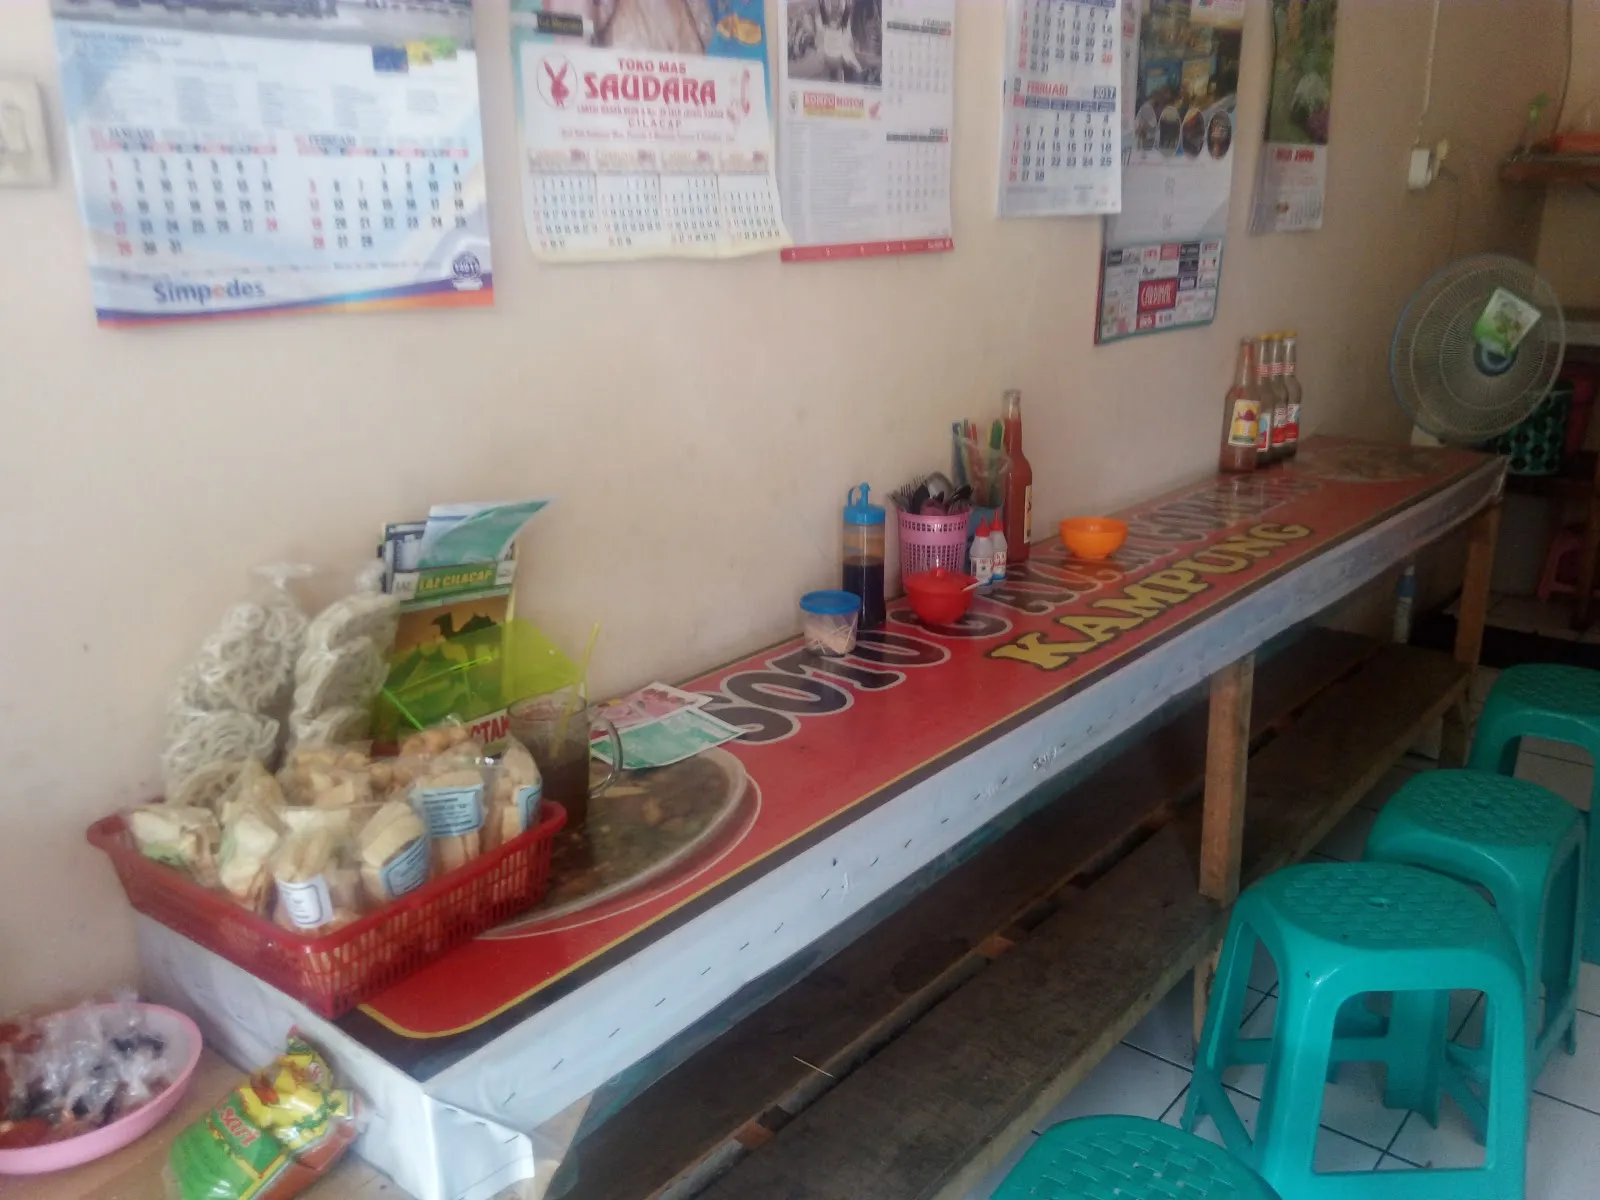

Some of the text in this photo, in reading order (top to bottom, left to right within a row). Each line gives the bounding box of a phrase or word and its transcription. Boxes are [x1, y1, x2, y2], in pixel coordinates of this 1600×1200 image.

[618, 58, 686, 74] TOKO MAS
[584, 72, 716, 106] SAUDARA
[628, 119, 682, 130] CILACAP
[1067, 143, 1077, 152] 16
[1084, 143, 1093, 152] 17
[1051, 157, 1061, 167] 22
[1082, 157, 1093, 167] 24
[154, 277, 265, 306] Simpedes
[984, 521, 1312, 669] KAMPUNG
